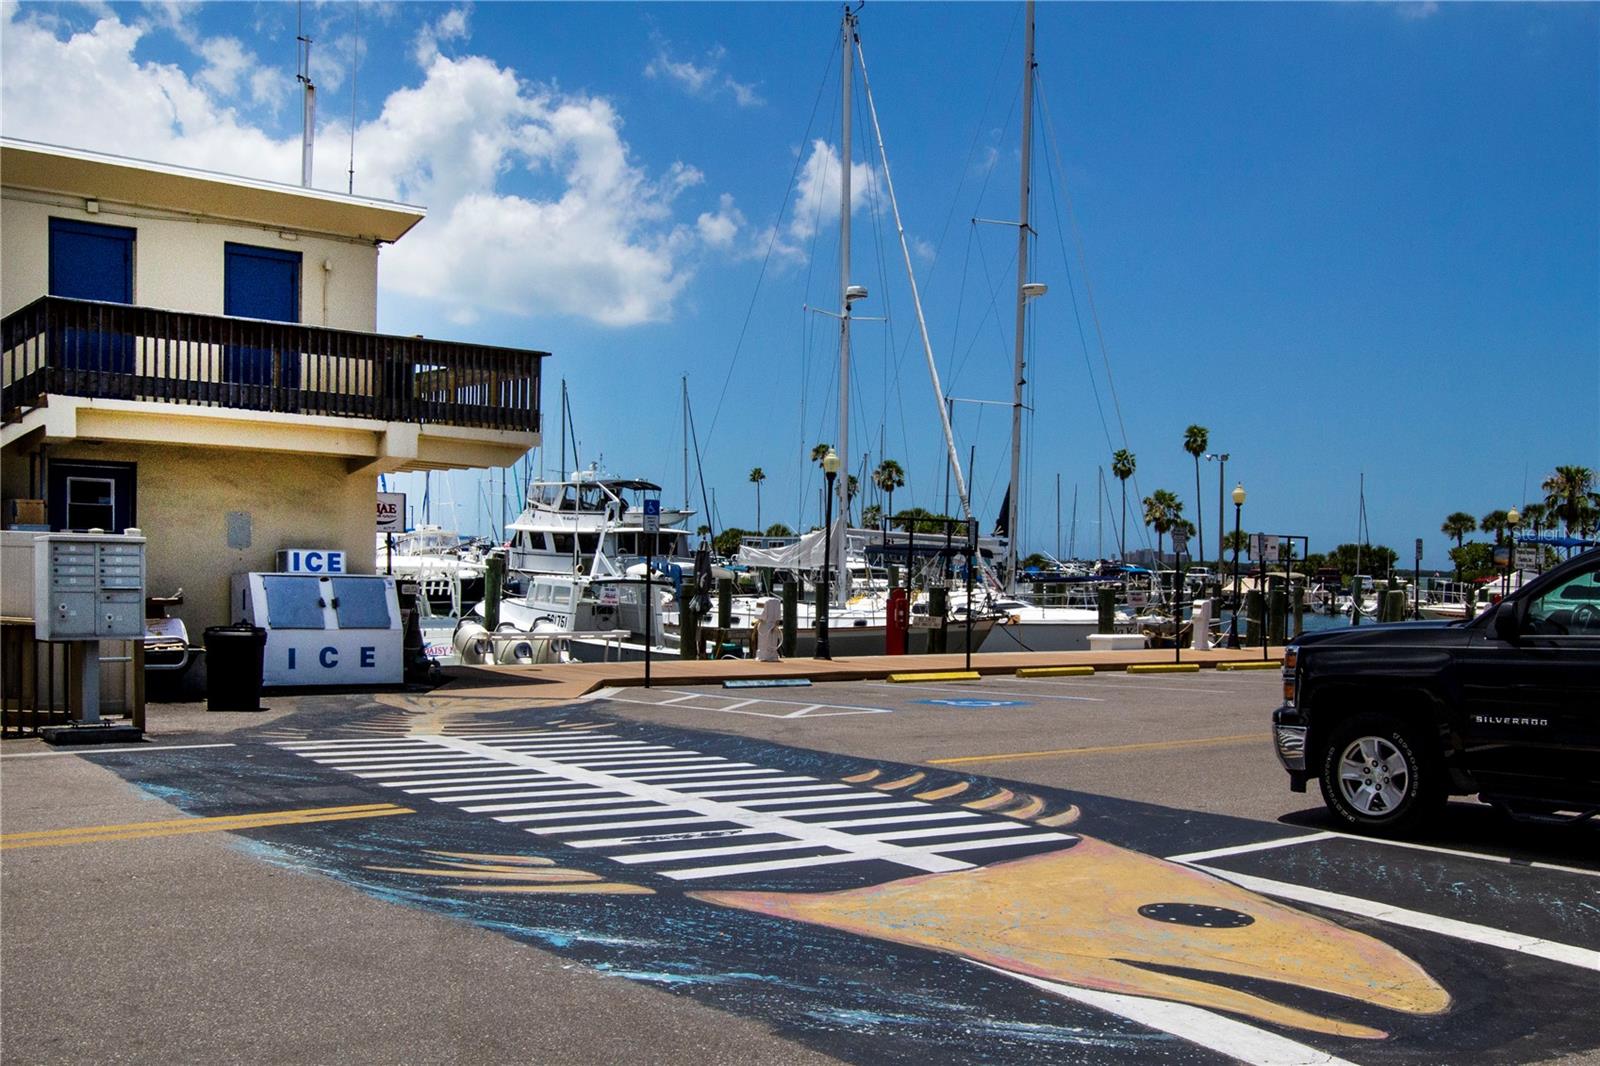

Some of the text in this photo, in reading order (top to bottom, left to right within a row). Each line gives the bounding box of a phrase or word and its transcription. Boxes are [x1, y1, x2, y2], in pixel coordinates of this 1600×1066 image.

[293, 552, 342, 572] ICE
[288, 646, 376, 670] ICE
[1476, 716, 1548, 726] SILVERADO
